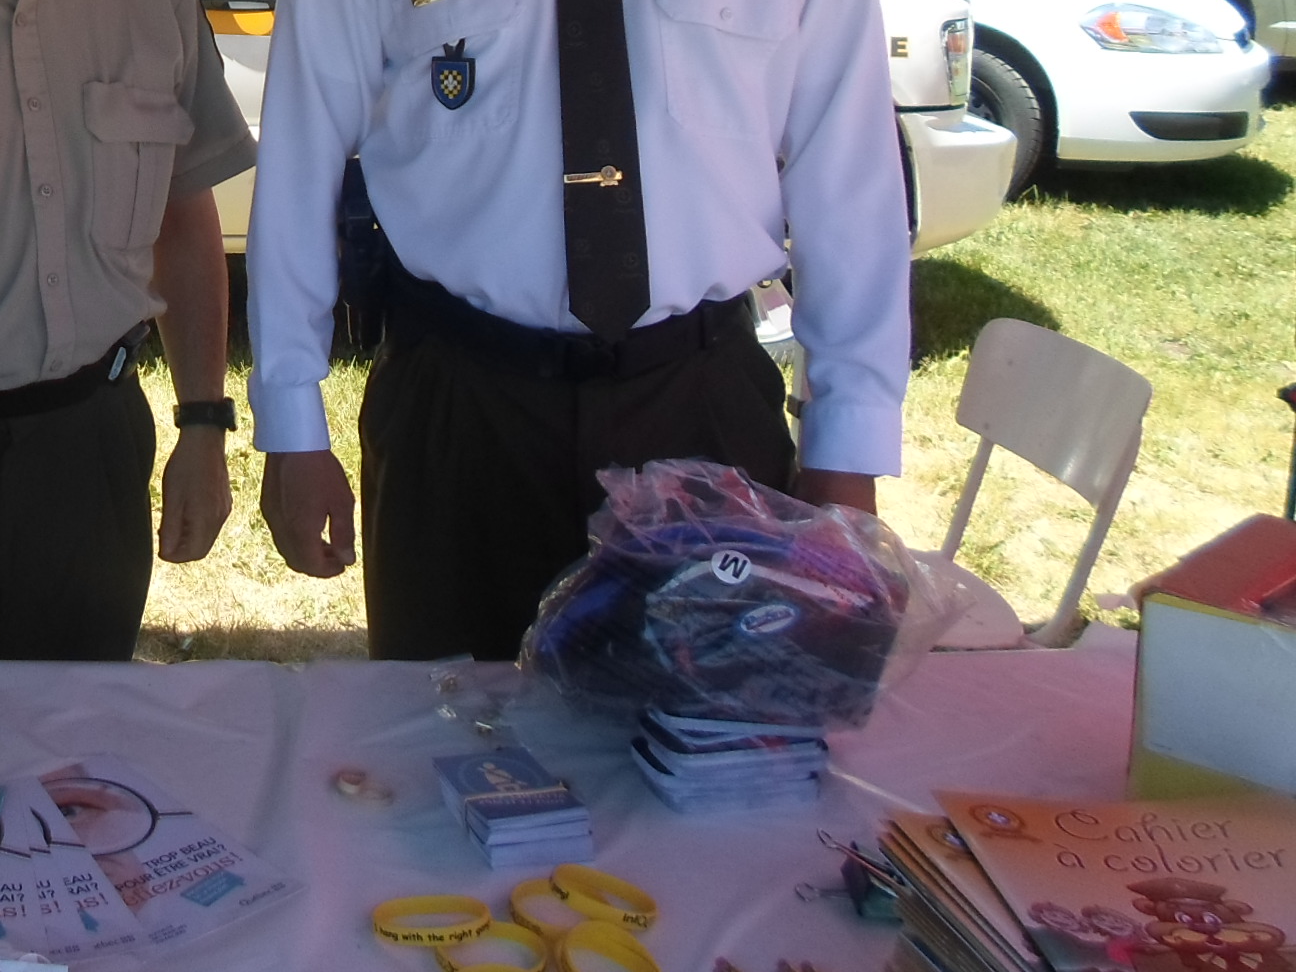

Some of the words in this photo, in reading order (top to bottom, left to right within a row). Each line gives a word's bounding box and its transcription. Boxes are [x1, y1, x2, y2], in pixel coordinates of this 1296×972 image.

[1054, 808, 1234, 844] Cahier
[179, 835, 218, 856] BEAU
[1056, 844, 1085, 869] à
[1104, 843, 1287, 875] colorier
[401, 931, 424, 942] with
[427, 932, 445, 942] the
[448, 928, 472, 943] right
